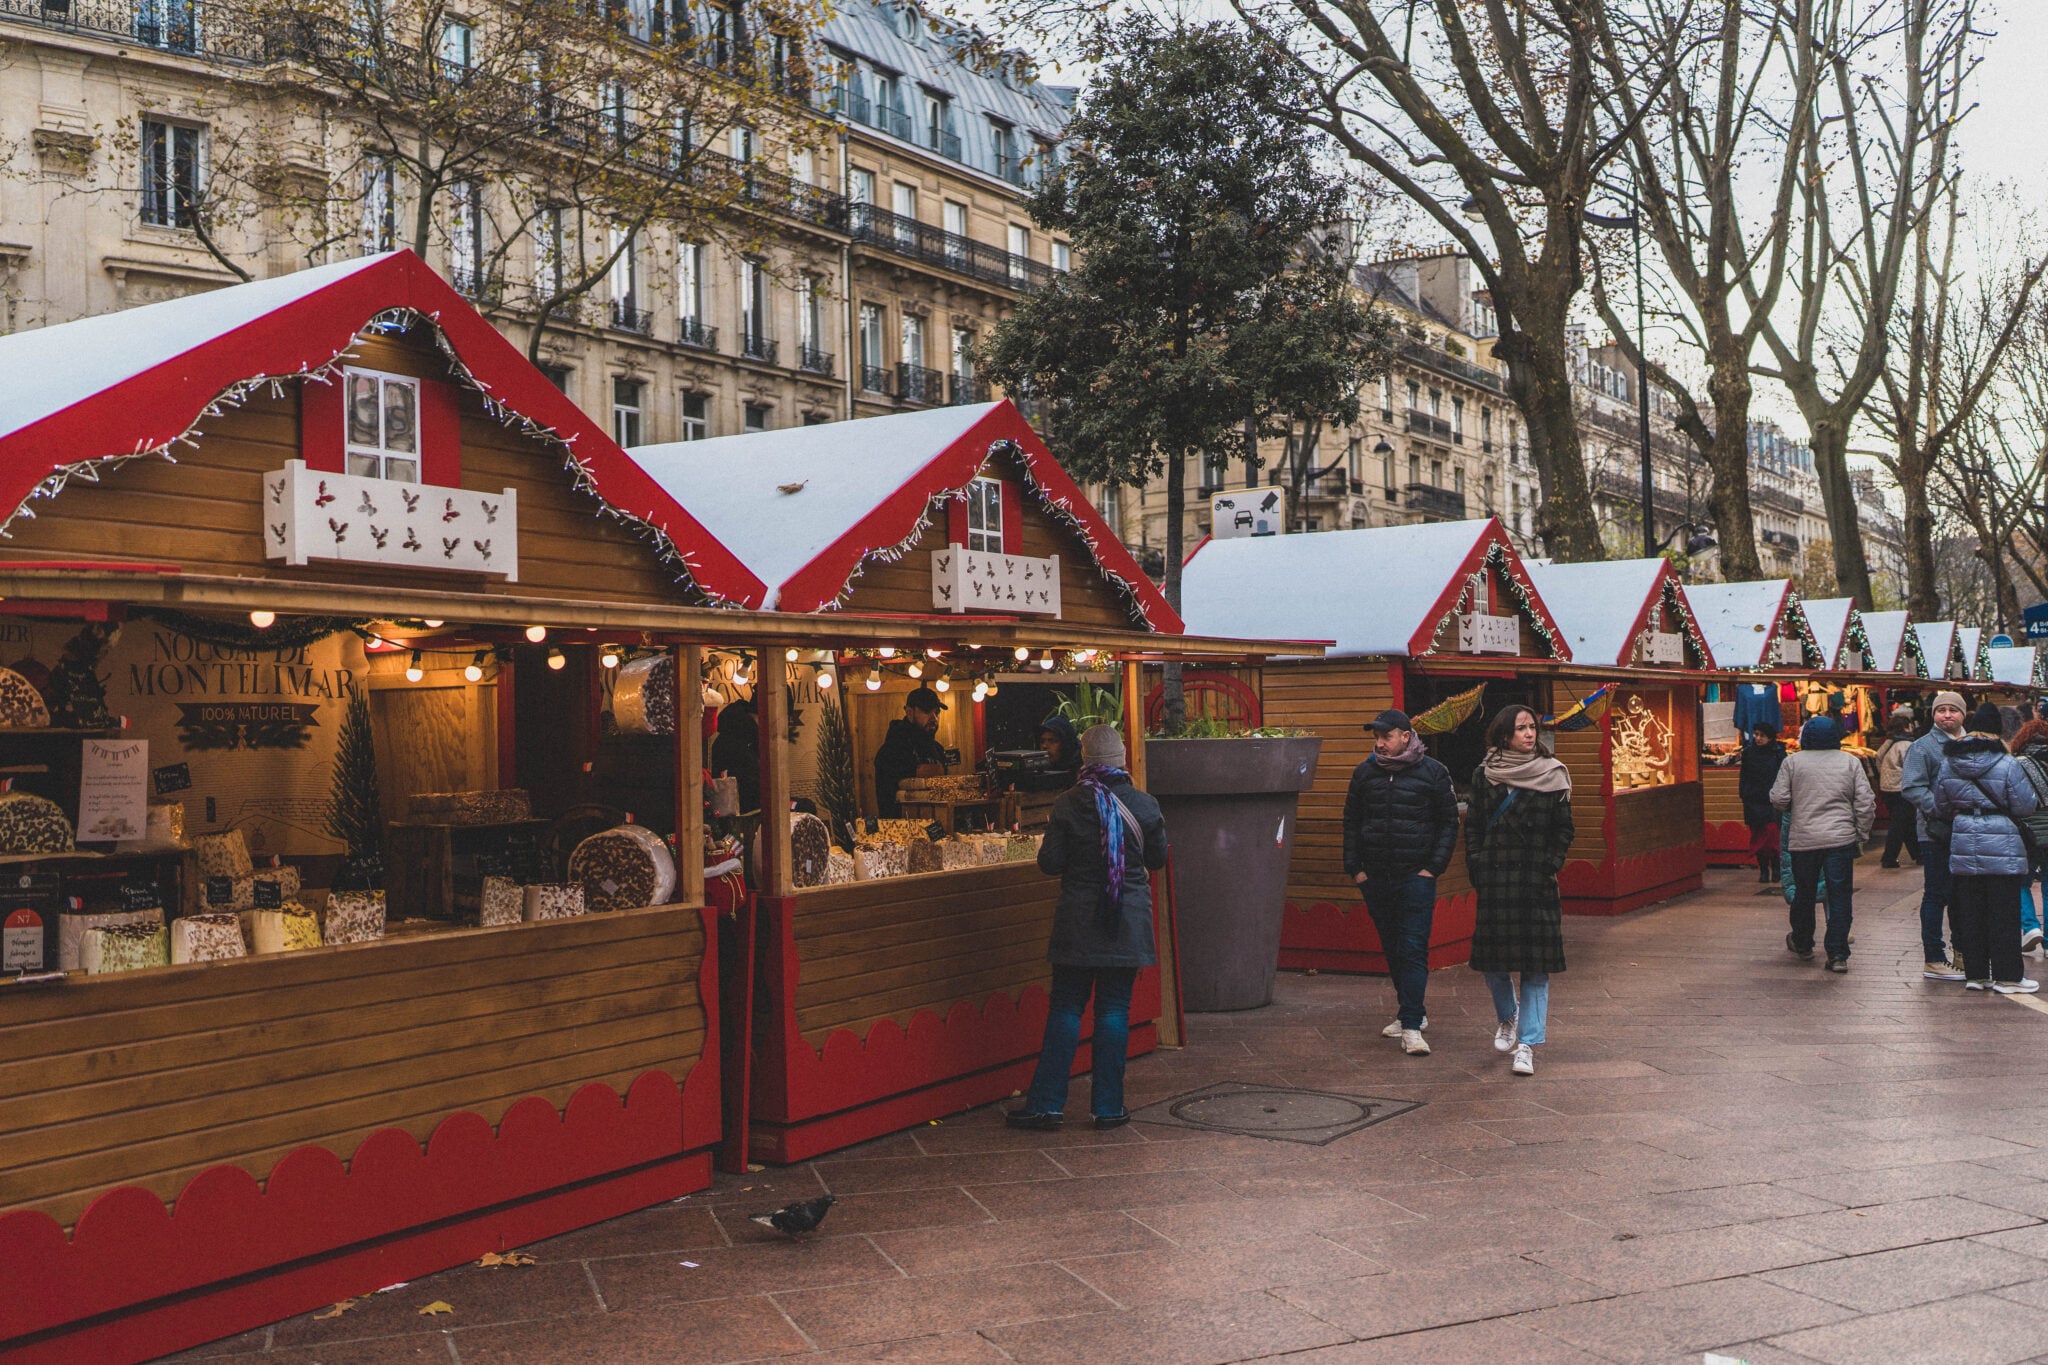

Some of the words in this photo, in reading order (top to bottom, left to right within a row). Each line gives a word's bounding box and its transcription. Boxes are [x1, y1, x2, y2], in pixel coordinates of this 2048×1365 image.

[2030, 622, 2040, 634] 4
[129, 663, 353, 698] MONTELIMAR
[202, 707, 235, 721] 100%
[239, 706, 300, 721] NATUREL
[17, 915, 30, 924] N7
